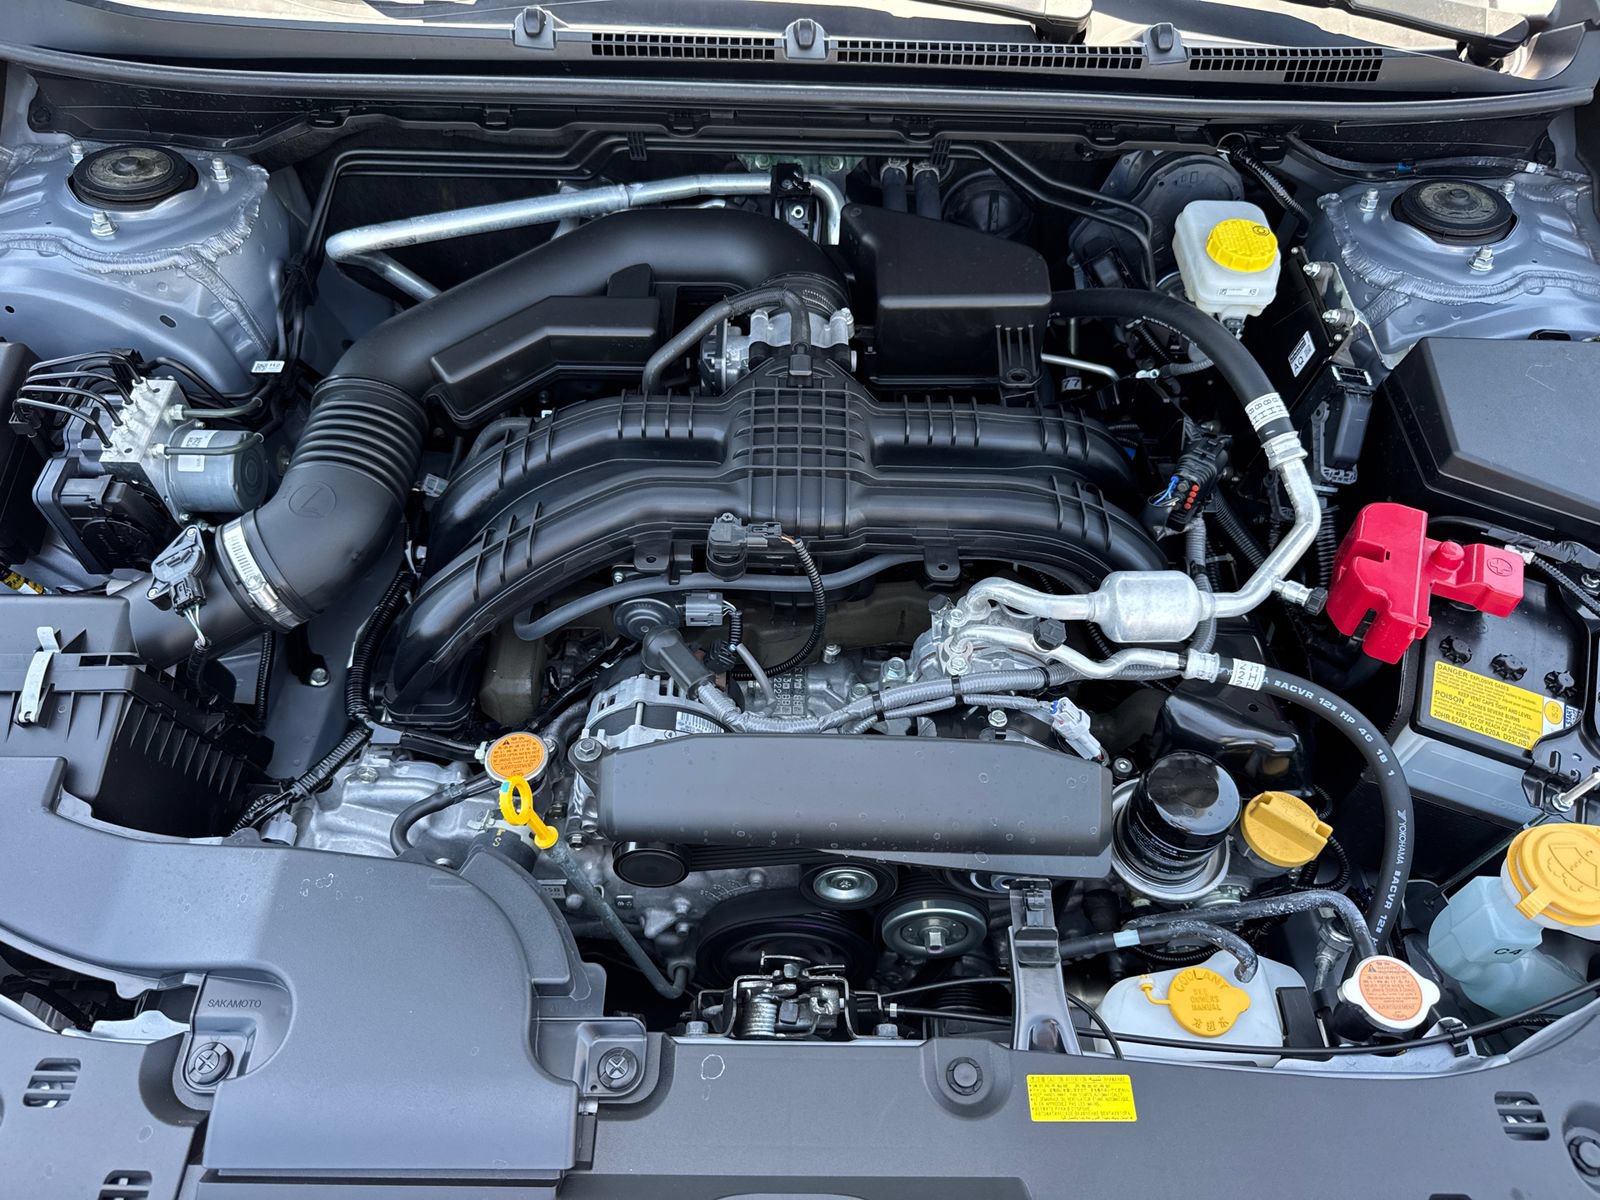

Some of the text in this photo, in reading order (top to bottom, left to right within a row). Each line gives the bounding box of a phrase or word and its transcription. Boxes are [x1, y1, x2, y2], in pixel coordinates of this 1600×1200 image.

[1437, 663, 1467, 678] DANGER
[1434, 689, 1464, 704] POISON
[1396, 820, 1406, 864] YOKOHAMA
[1174, 970, 1228, 992] COOLANT
[208, 999, 262, 1008] SAKAMOTO
